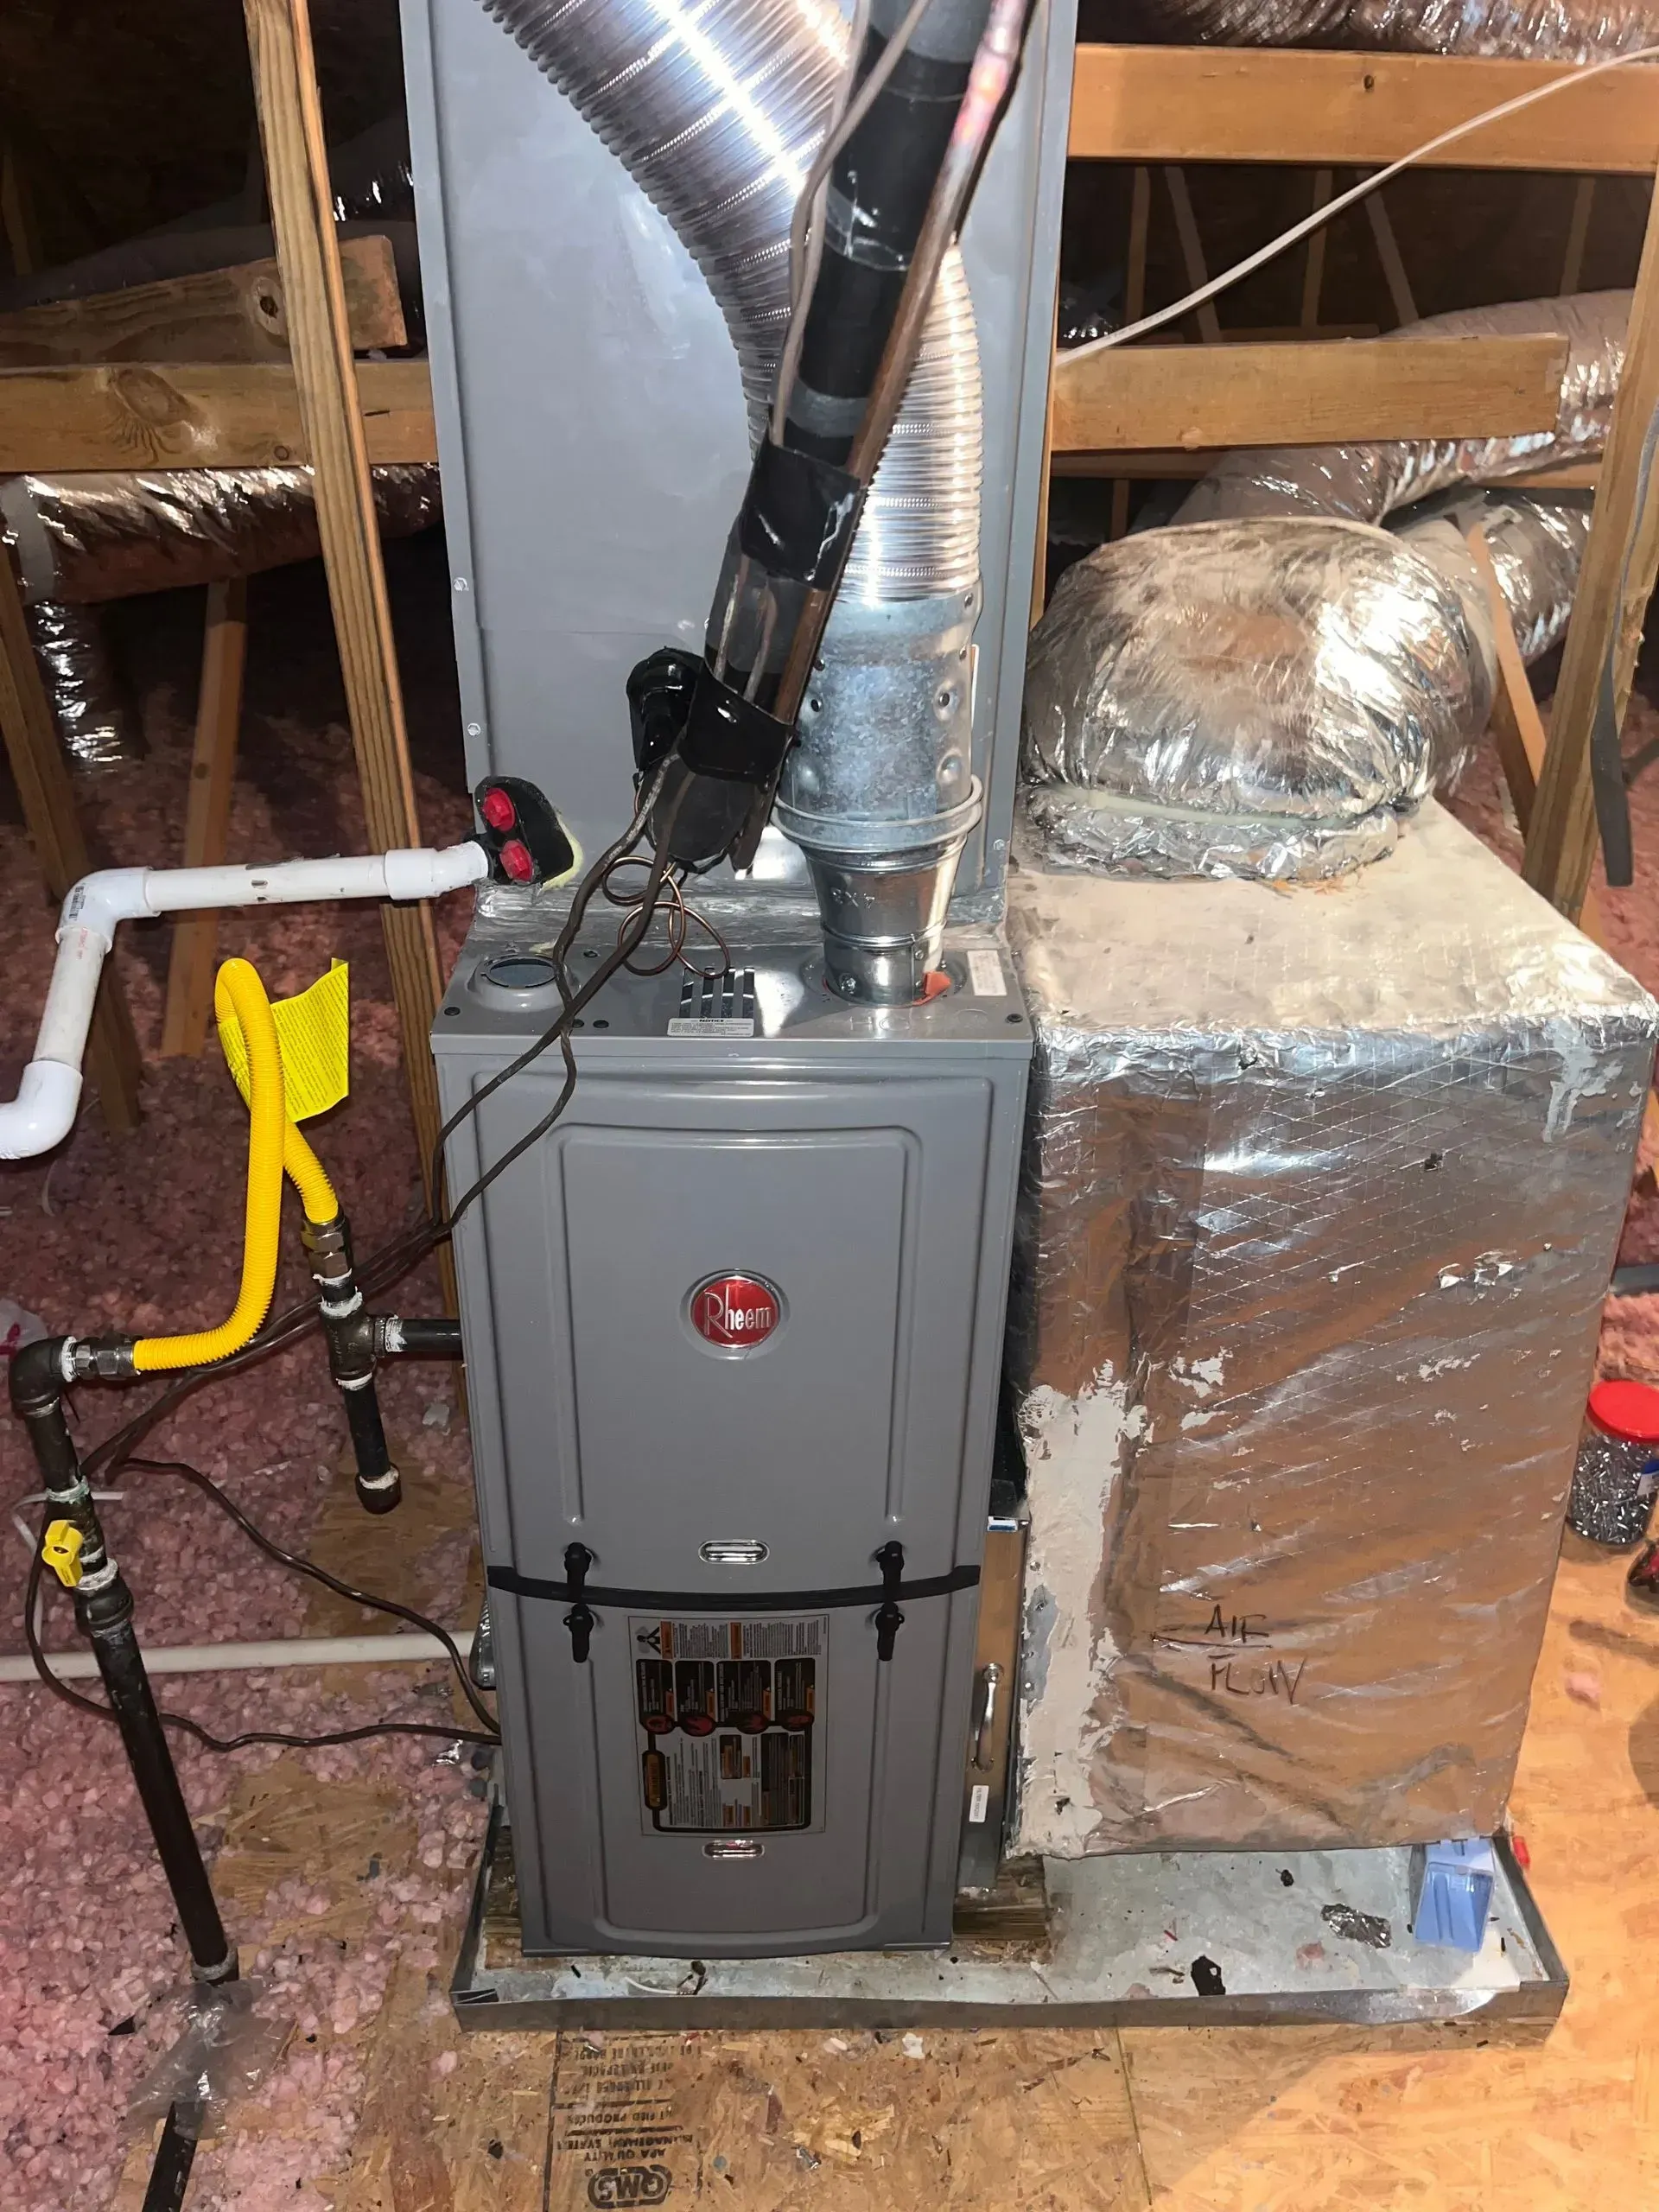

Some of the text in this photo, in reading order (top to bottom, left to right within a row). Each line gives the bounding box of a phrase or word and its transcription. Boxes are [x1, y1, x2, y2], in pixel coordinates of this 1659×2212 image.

[703, 1284, 772, 1338] Rheem
[582, 2148, 664, 2162] APA QUALITY
[597, 2171, 664, 2201] QMS
